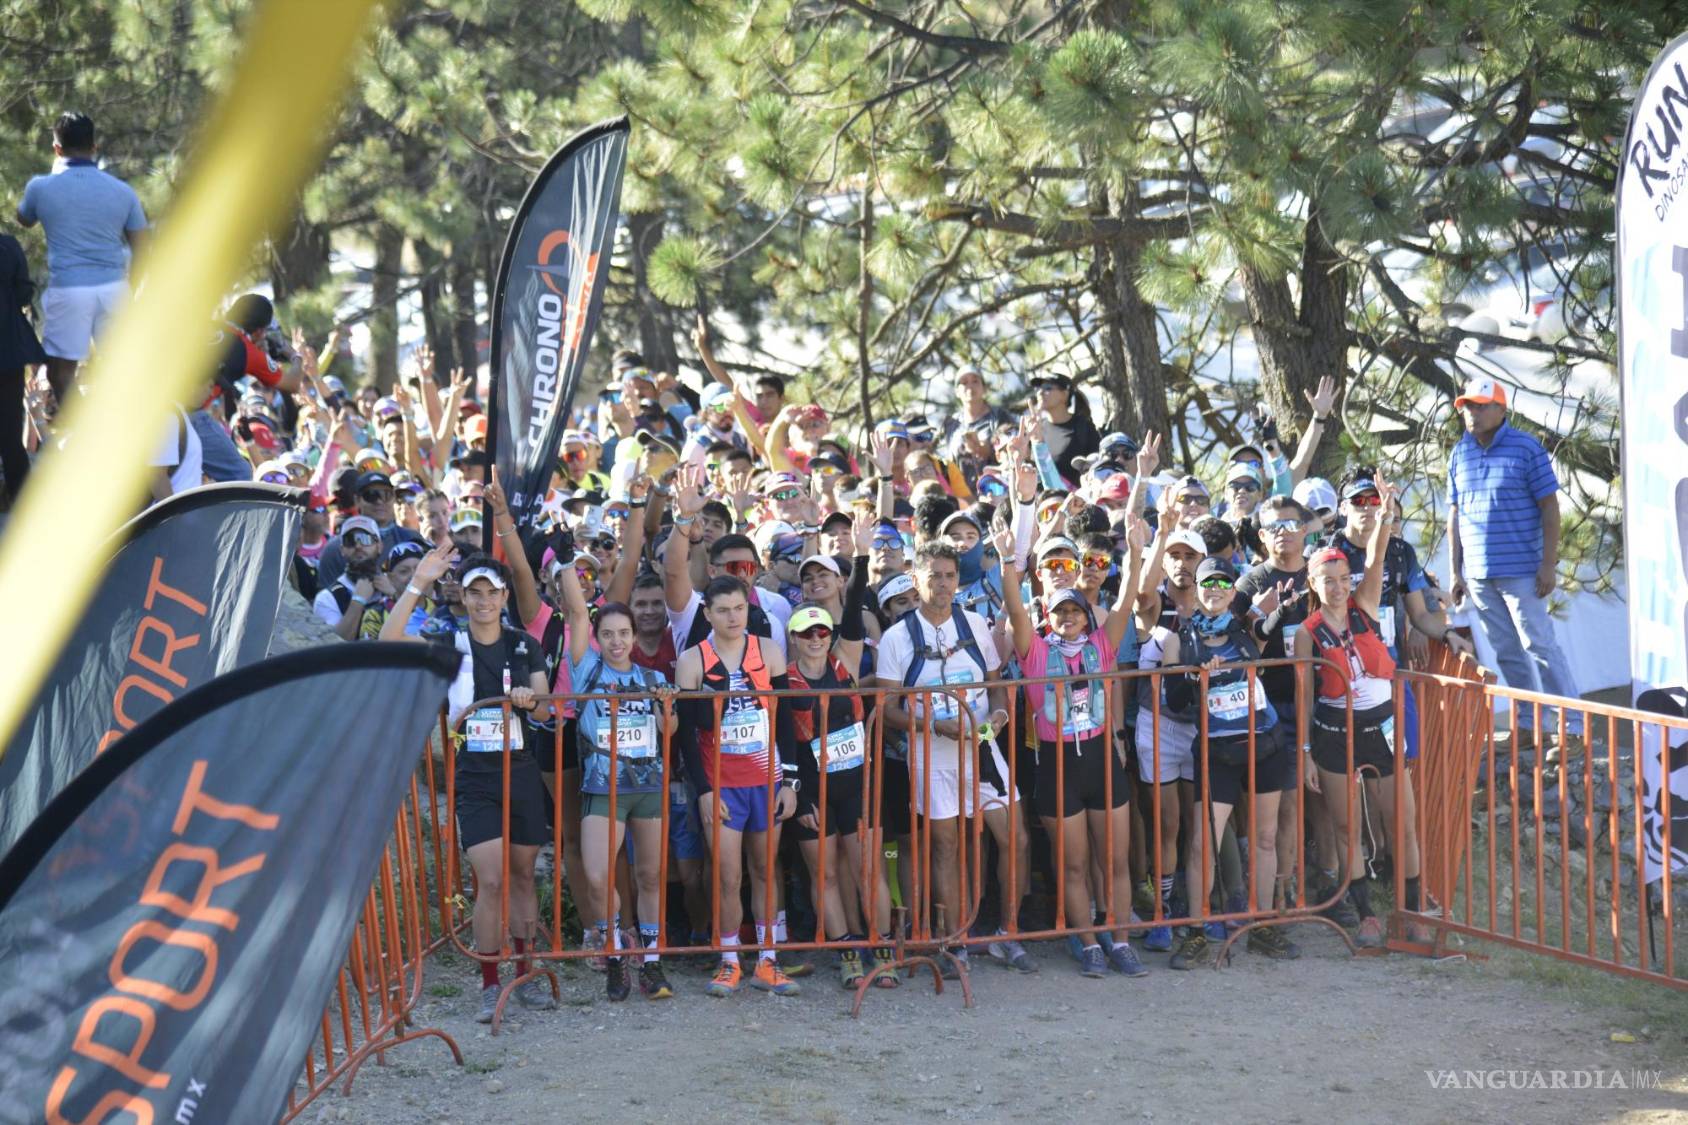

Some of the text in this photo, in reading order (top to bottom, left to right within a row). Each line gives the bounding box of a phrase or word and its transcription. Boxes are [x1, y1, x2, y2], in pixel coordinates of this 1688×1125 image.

[528, 294, 562, 449] CHRONO
[1230, 690, 1246, 703] 40
[618, 729, 641, 742] 210
[732, 725, 755, 738] 107
[834, 740, 857, 758] 106
[45, 760, 279, 1125] SPORT
